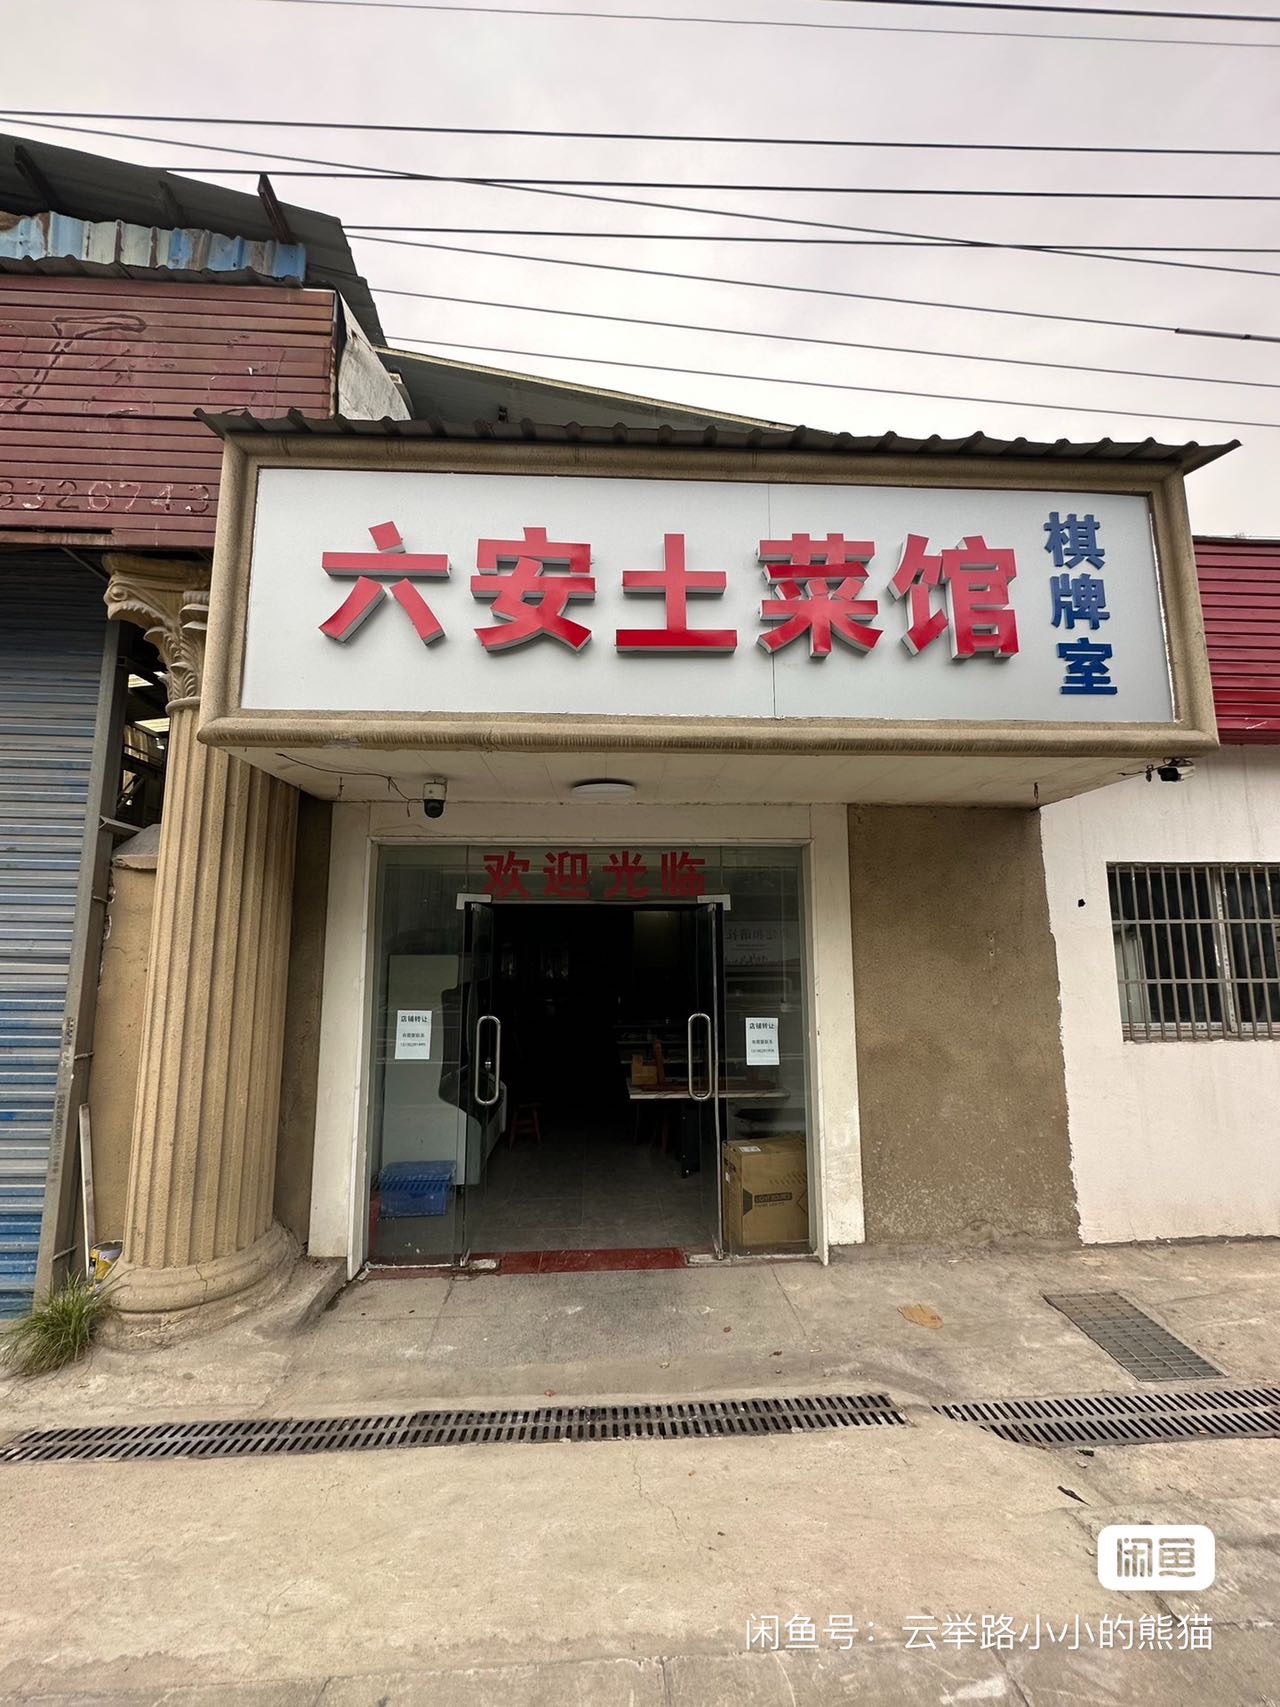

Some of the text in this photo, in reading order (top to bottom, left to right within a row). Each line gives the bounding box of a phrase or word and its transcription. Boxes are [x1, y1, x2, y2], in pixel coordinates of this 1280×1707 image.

[318, 521, 1020, 659] 六安土菜馆
[1043, 511, 1118, 695] 棋牌室
[483, 851, 706, 898] 欢迎光临
[400, 1015, 428, 1023] 店铺转让
[749, 1022, 775, 1030] 店铺转让
